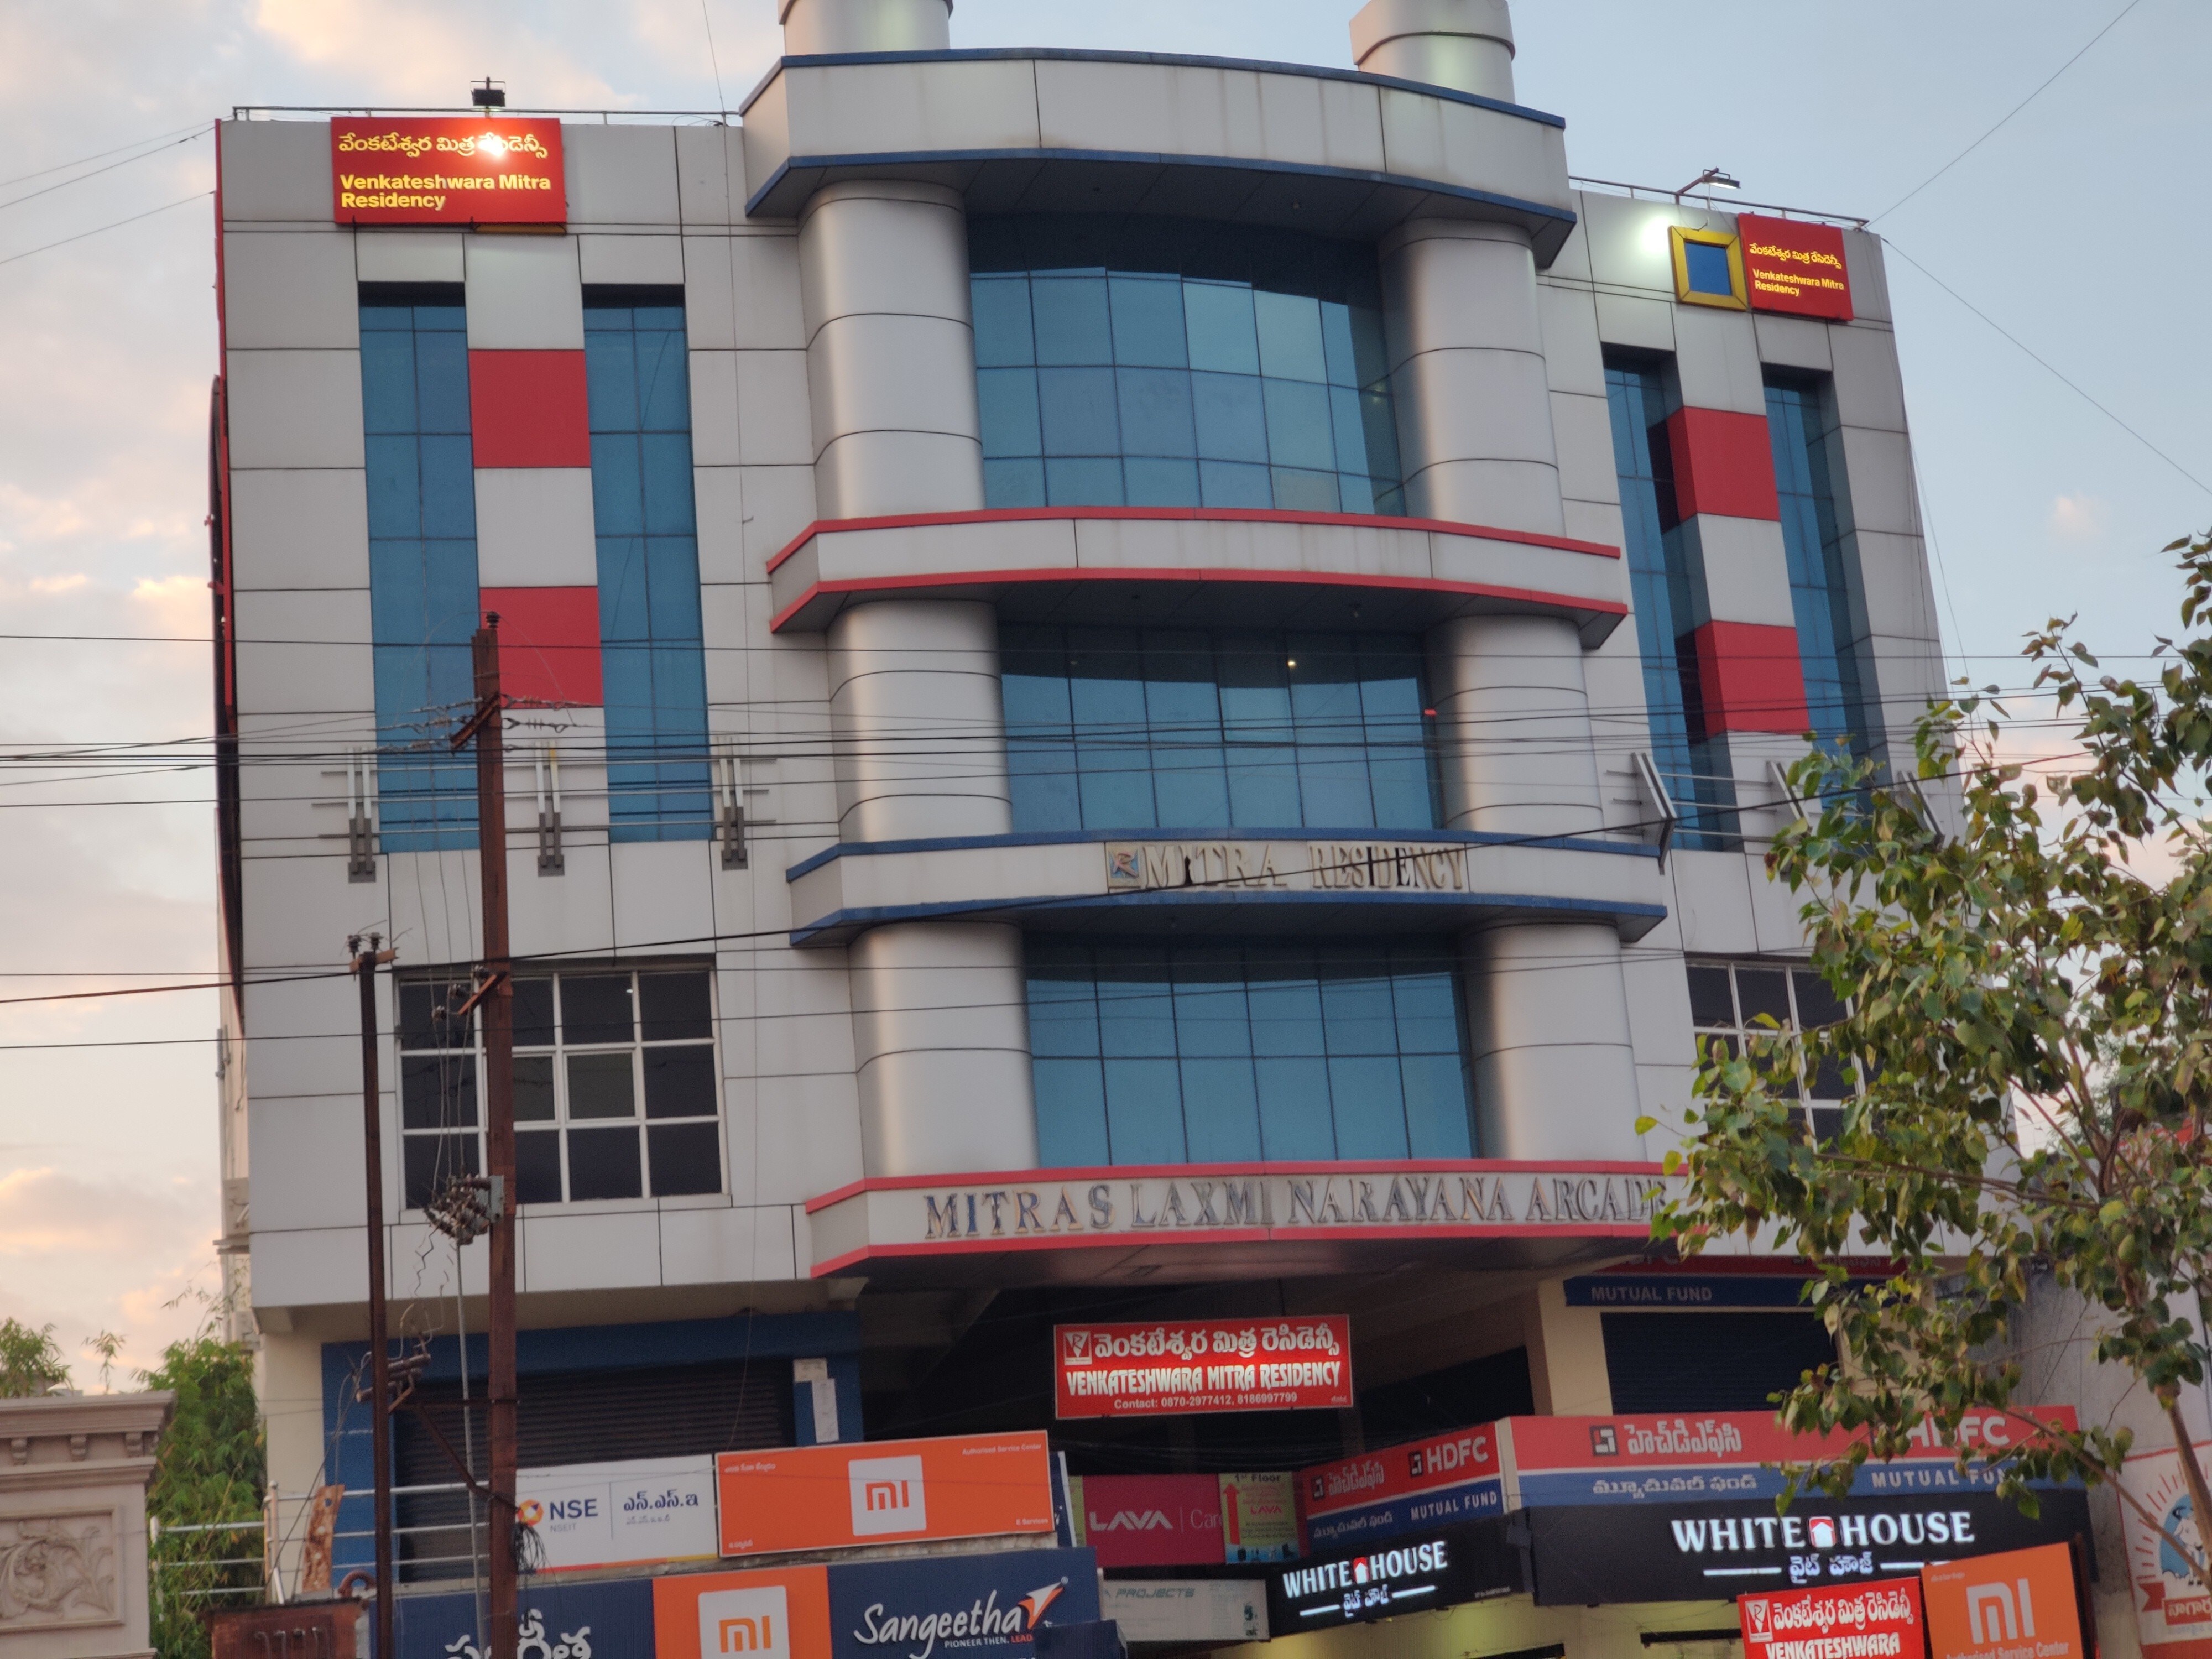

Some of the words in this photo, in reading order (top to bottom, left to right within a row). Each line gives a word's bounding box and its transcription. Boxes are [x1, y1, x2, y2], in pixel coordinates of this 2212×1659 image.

[338, 132, 432, 158] వేంకటేశ్వర
[436, 135, 475, 157] మిత్ర
[340, 174, 495, 190] Venkateshwara
[499, 174, 551, 190] Mitra
[341, 192, 446, 212] Residency
[1792, 251, 1811, 264] మిత్ర
[1752, 268, 1820, 287] Venkateshwara
[1821, 278, 1845, 291] Mitra
[1754, 280, 1800, 297] Residency
[1142, 844, 1288, 890] MITRA
[1309, 844, 1467, 890] RESIDENCY
[924, 1183, 1115, 1240] MITRAS
[1130, 1179, 1275, 1229] LAXMI
[1288, 1176, 1515, 1224] NARAYANA
[1590, 1286, 1662, 1302] MUTUAL
[1666, 1286, 1713, 1302] FUND
[1093, 1327, 1208, 1360] వెంకటేశ్వర
[1212, 1327, 1257, 1358] మిత్ర
[1066, 1366, 1203, 1397] VENKATESHWARA
[1207, 1364, 1255, 1391] MITRA
[1259, 1361, 1340, 1390] RESIDENCY
[1114, 1399, 1158, 1410] Contact:
[1426, 1436, 1489, 1474] HDFC
[1251, 1473, 1281, 1482] Floor
[1871, 1469, 1959, 1489] MUTUAL
[1968, 1468, 2025, 1485] FUN
[549, 1498, 598, 1520] NSE
[1250, 1505, 1282, 1514] LAVA
[1410, 1499, 1459, 1521] MUTUAL
[1464, 1491, 1498, 1511] FUND
[1088, 1510, 1173, 1531] LAVA
[1190, 1508, 1223, 1529] Car
[1671, 1516, 1806, 1552] WHITE
[1839, 1511, 1975, 1547] HOUSE
[1283, 1561, 1353, 1599] WHITE
[1369, 1541, 1448, 1581] HOUSE
[1789, 1553, 1821, 1584] వైట్
[853, 1589, 1020, 1659] Sangeetha
[1837, 1595, 1866, 1631] మిత్ర
[944, 1637, 982, 1648] PIONEER
[984, 1636, 1010, 1645] THEN.
[1010, 1634, 1034, 1644] LEAD
[1765, 1632, 1901, 1659] VENKATESHWARA
[2036, 1641, 2069, 1657] Center
